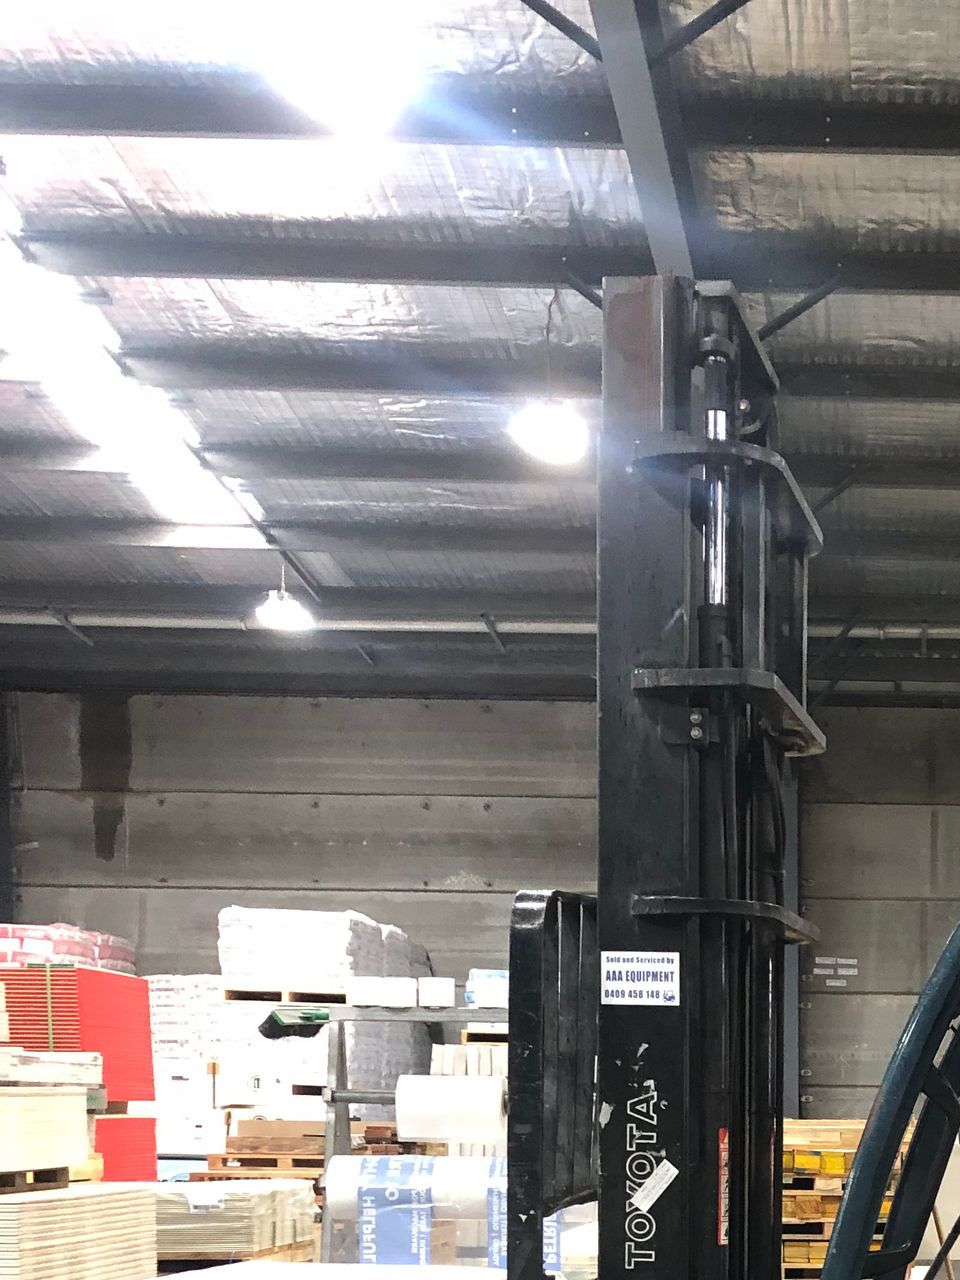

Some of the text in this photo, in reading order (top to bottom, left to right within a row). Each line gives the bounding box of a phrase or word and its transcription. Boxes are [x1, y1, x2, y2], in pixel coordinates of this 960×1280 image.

[636, 956, 665, 964] Serviced
[666, 957, 674, 965] by
[605, 970, 675, 983] AAA EQUIPMENT
[604, 989, 626, 998] 0409
